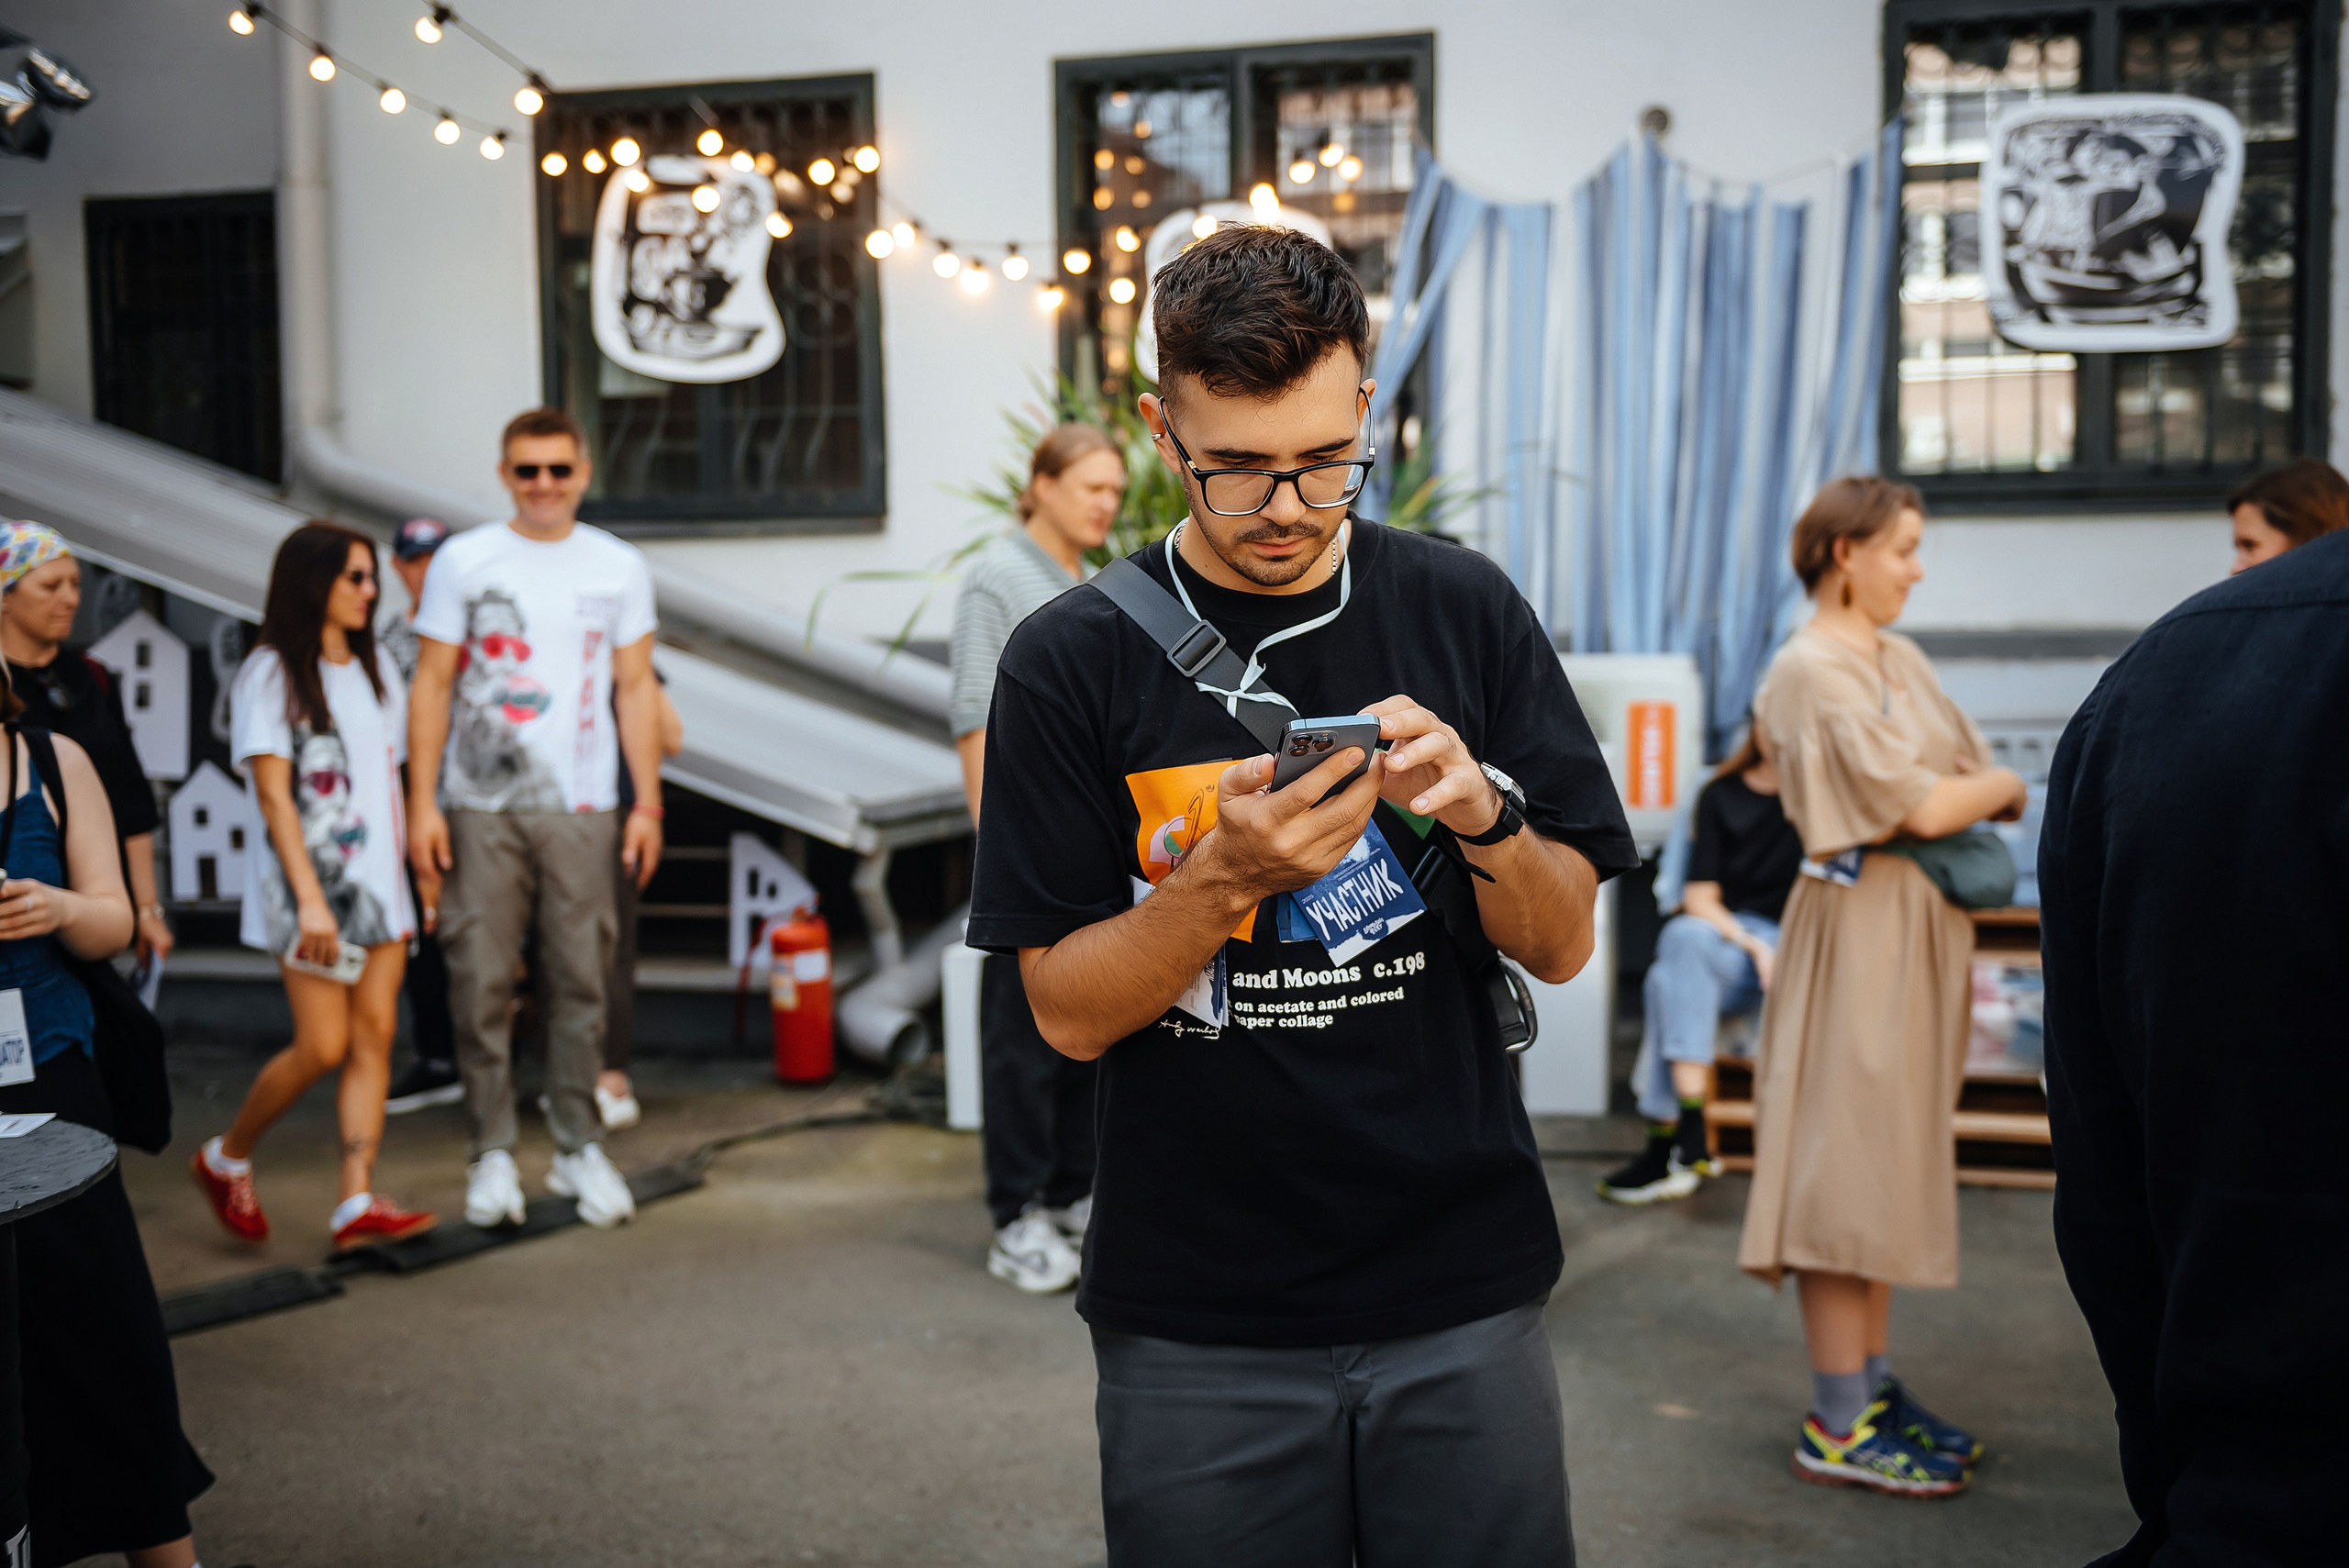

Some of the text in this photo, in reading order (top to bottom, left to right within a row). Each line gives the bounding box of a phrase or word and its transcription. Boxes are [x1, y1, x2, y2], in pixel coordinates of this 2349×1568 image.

[1306, 858, 1404, 941] УЧАСТНИК
[1232, 951, 1425, 989] and Moons c.198
[1234, 986, 1405, 1014] on acetate and colored
[1278, 1014, 1333, 1029] collage
